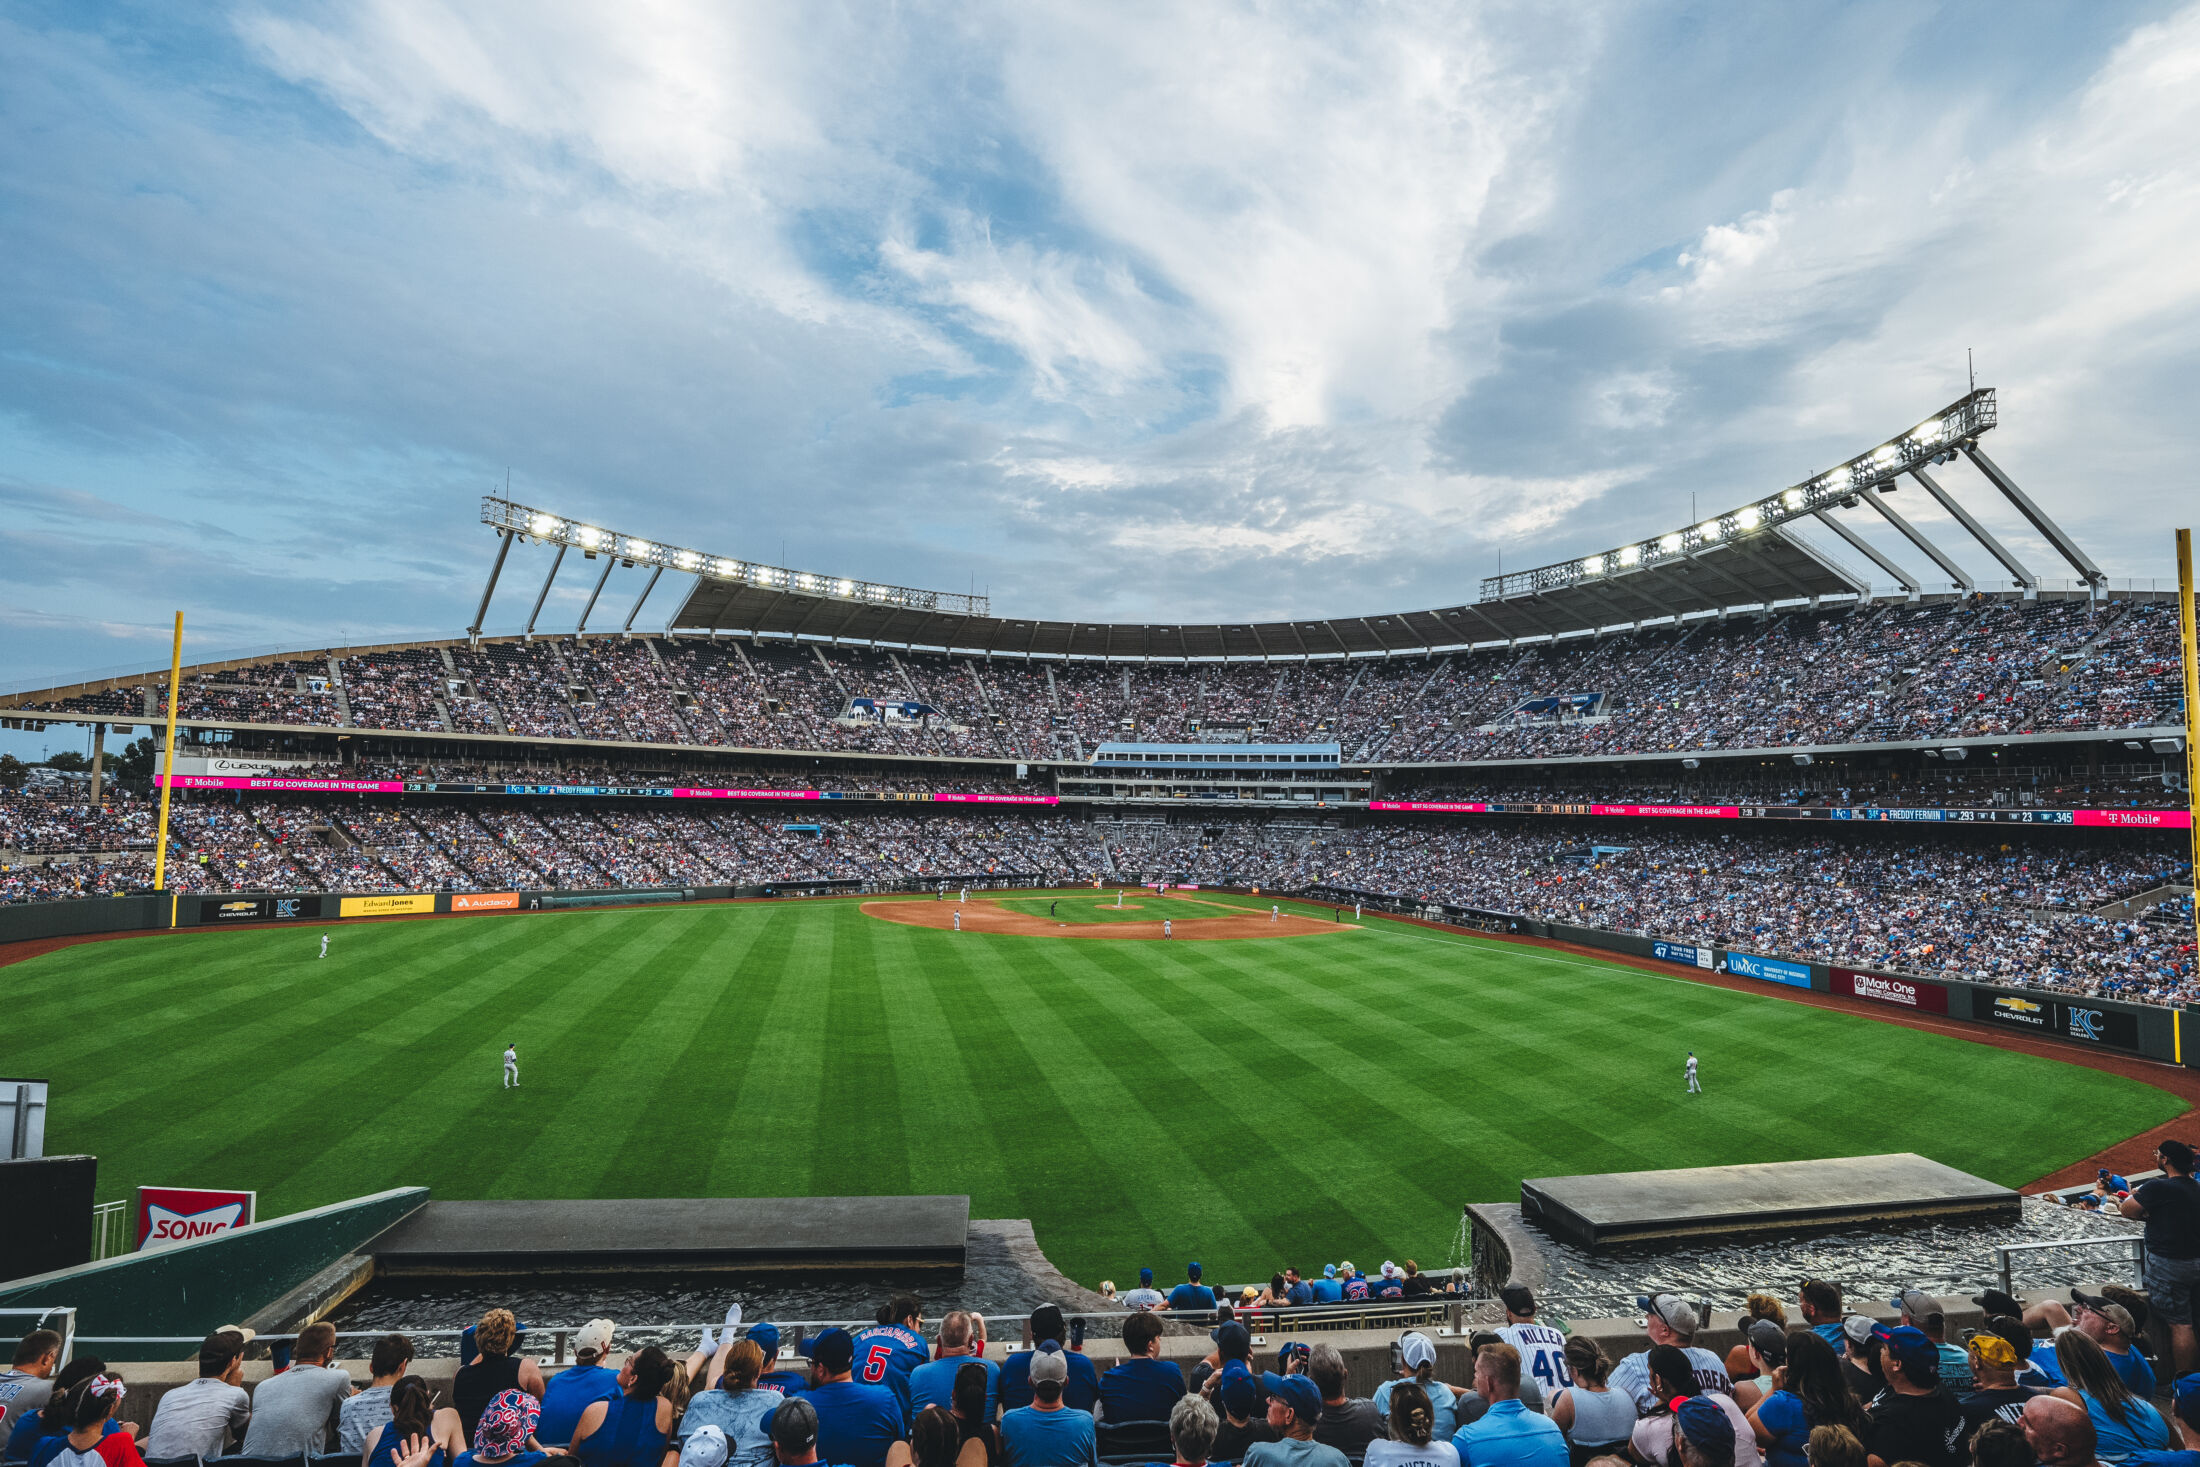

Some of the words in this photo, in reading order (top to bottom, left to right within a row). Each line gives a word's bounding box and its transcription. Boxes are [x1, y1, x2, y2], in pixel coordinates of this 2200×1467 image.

[194, 778, 224, 786] Mobile
[1890, 810, 1914, 820] FREDDY
[1914, 810, 1940, 820] FERMIN
[1958, 811, 1974, 820] .293
[1990, 812, 1996, 821] 4
[2022, 812, 2032, 822] 23
[2053, 812, 2072, 822] .345
[2108, 813, 2118, 824] T
[2120, 814, 2160, 824] Mobile
[276, 898, 300, 917] KC
[1655, 946, 1666, 958] 47
[1731, 958, 1760, 976] UMKC
[1866, 976, 1890, 990] Mark
[1892, 982, 1916, 995] One
[1994, 1010, 2043, 1024] CHEVROLET
[2068, 1006, 2104, 1040] KC
[1518, 1330, 1562, 1346] MILLER
[863, 1344, 892, 1382] 5
[1532, 1350, 1574, 1388] 40
